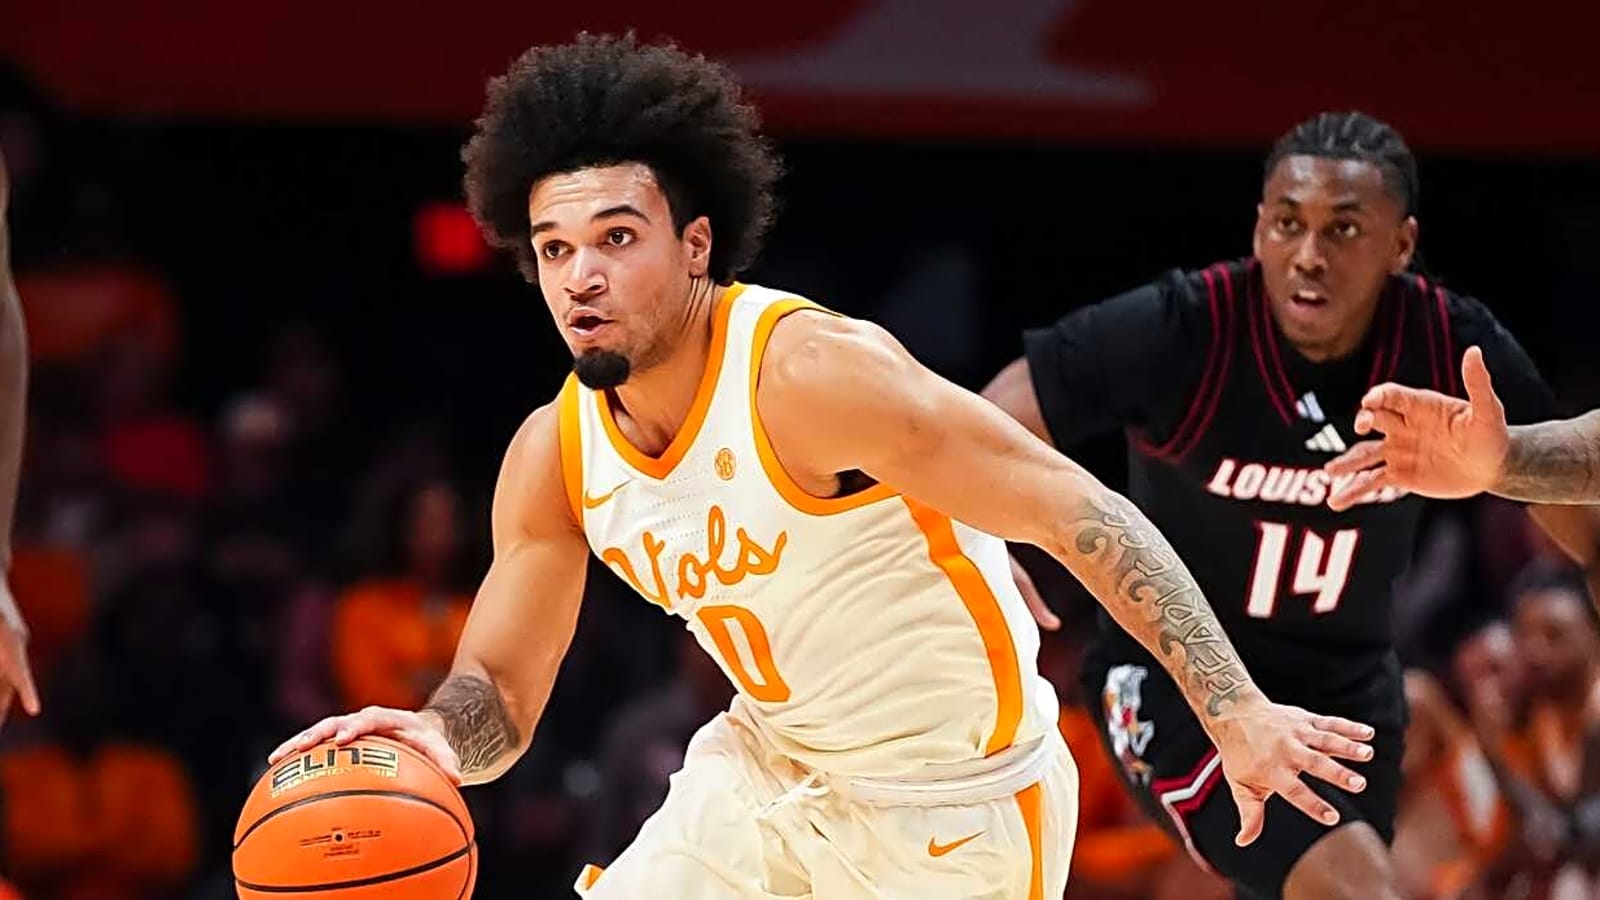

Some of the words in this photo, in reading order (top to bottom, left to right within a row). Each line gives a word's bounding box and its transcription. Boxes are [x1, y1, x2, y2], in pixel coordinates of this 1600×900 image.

[602, 504, 788, 608] Vols
[1245, 520, 1360, 619] 14
[696, 605, 792, 703] 0
